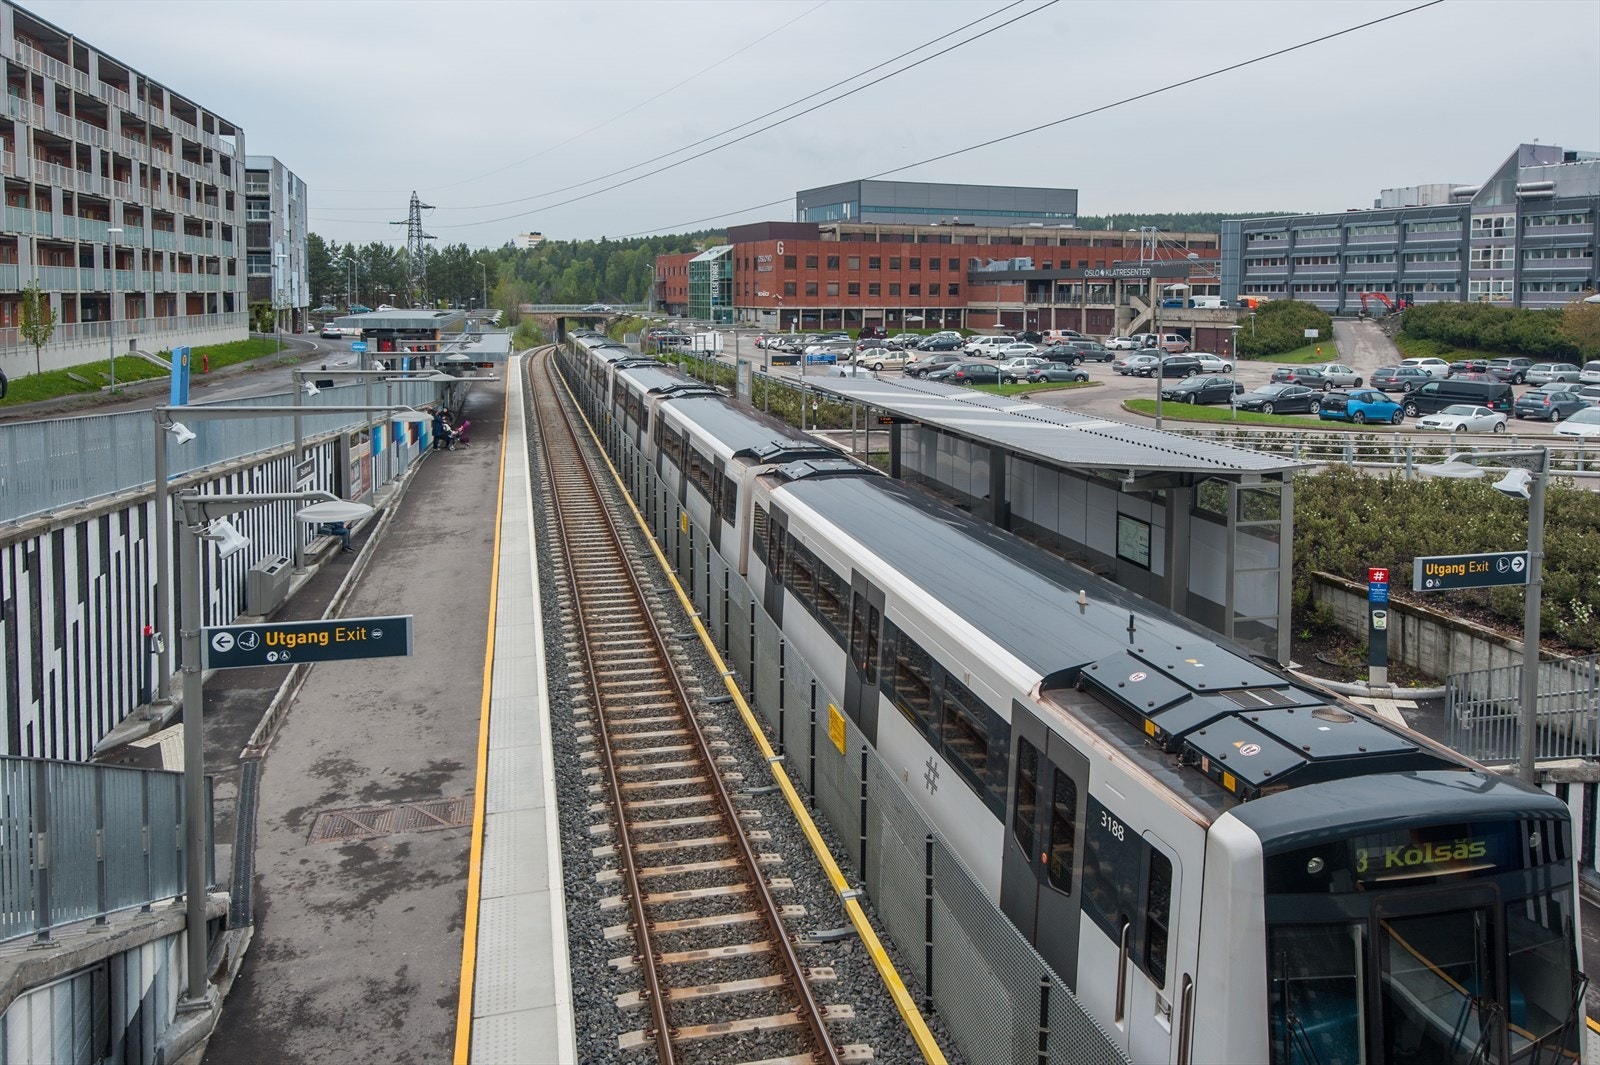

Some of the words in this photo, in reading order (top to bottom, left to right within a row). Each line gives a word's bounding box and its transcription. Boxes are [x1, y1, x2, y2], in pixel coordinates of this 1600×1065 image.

[777, 241, 784, 255] G
[1105, 268, 1150, 276] KLATRESENTER
[1426, 564, 1466, 577] Utgang
[1469, 561, 1489, 572] Exit
[266, 630, 329, 648] Utgang
[336, 627, 367, 642] Exit
[1101, 810, 1124, 842] 3188
[1385, 838, 1487, 868] Kolsås
